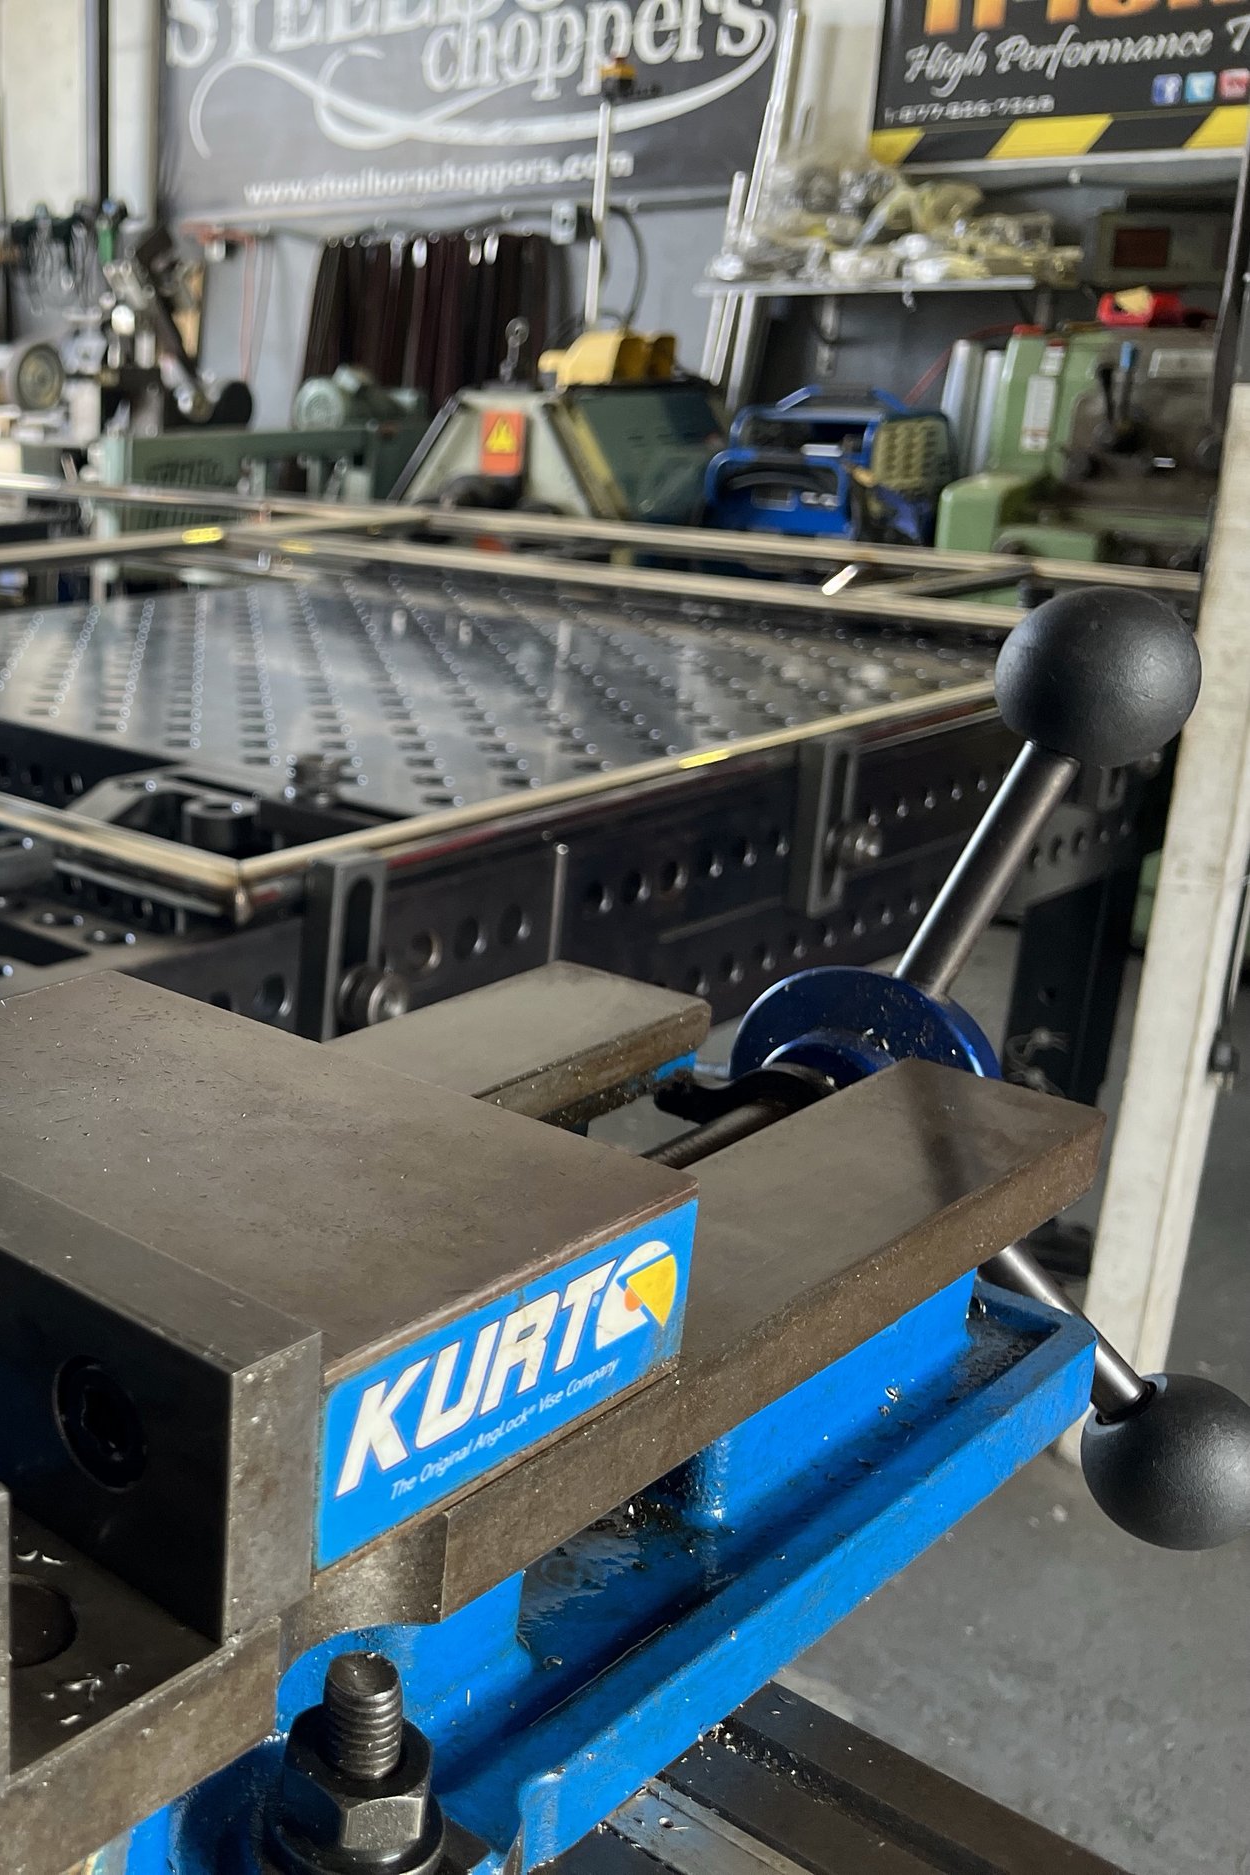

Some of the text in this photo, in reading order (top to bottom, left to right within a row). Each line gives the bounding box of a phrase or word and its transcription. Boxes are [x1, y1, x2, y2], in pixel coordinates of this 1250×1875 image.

[903, 32, 991, 98] High
[994, 24, 1213, 80] Performance
[335, 1257, 620, 1500] KURT
[391, 1475, 417, 1500] The
[420, 1439, 473, 1483] Original
[538, 1391, 565, 1413] Vise
[566, 1358, 620, 1397] Company
